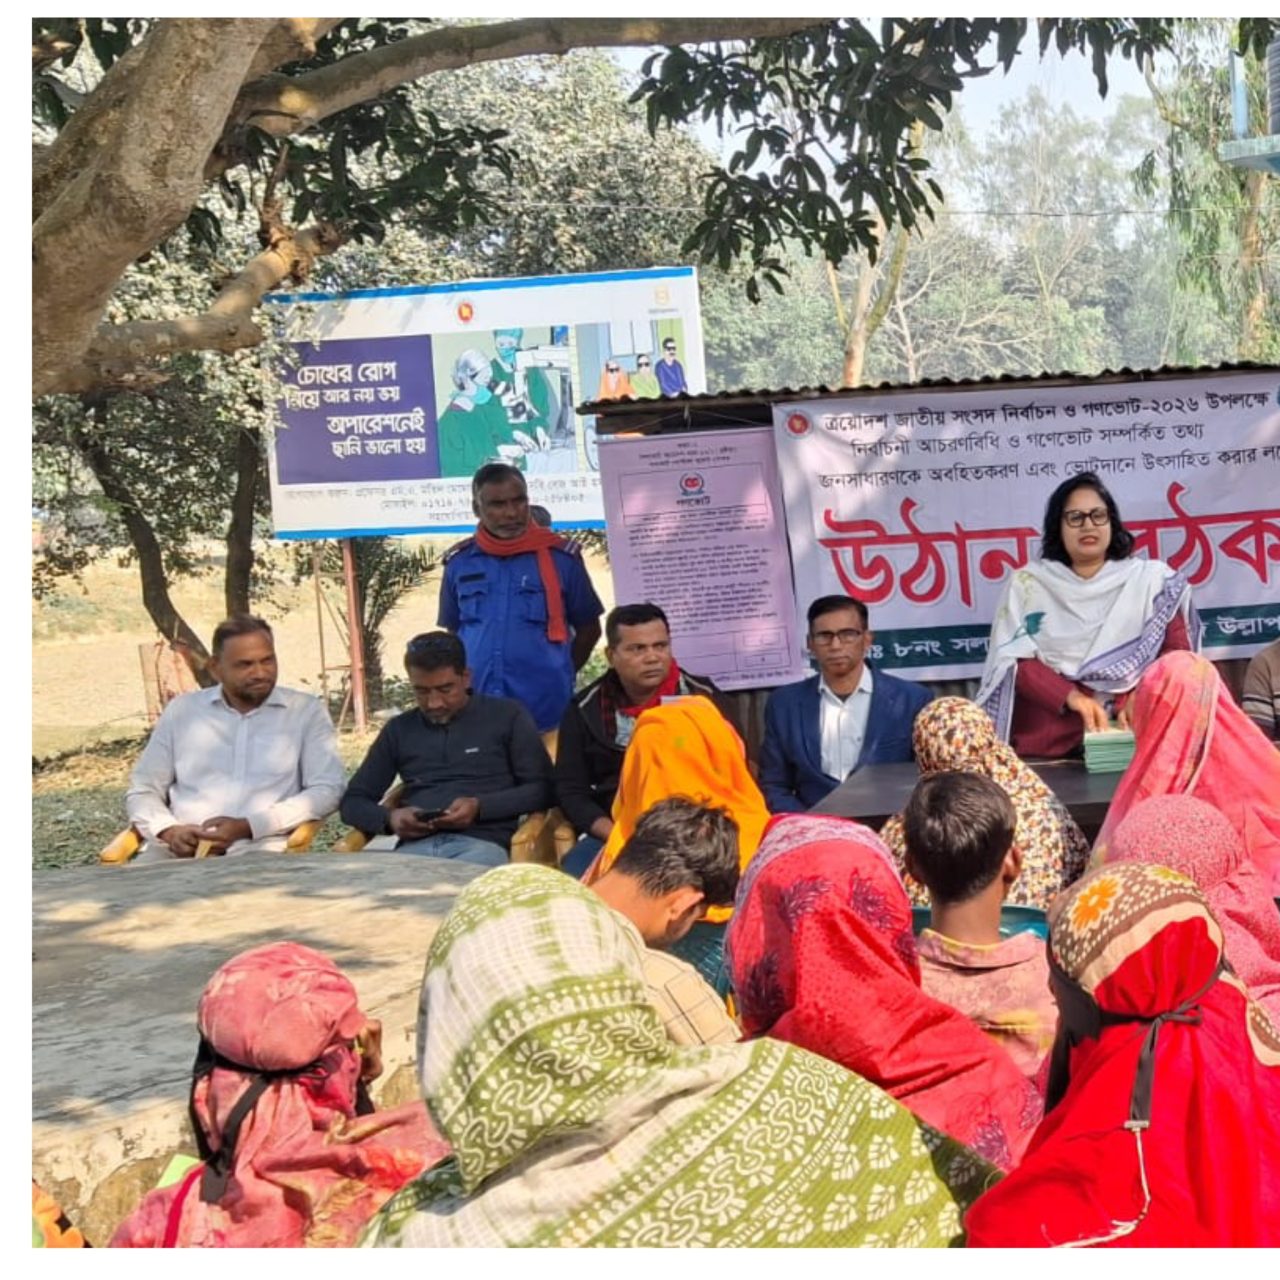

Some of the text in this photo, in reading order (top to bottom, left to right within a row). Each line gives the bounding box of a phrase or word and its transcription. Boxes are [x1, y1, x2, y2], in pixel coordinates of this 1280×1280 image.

[298, 361, 398, 384] চোখের রোগ
[322, 389, 350, 403] আর
[352, 388, 375, 403] নয়
[377, 386, 400, 402] ভয়
[326, 406, 426, 434] অপারেশনেই
[825, 390, 1270, 432] ত্রয়োদশ জাতীয় সংসদ নির্বাচন ও গণভোট-২০২৬ উপলক্ষে
[331, 436, 426, 458] ছানি ভালো হয়
[851, 422, 1205, 457] নির্বাচনী আচরণবিধি ও গণেভোট সম্পর্কিত তথ্য
[818, 470, 921, 489] জনসাধারণকে
[928, 462, 1019, 486] অবহিতকরণ
[1025, 463, 1057, 478] এবং
[1064, 455, 1136, 476] ভোটদানে
[1142, 447, 1212, 472] উৎসাহিত
[1217, 444, 1256, 464] করার
[819, 497, 1044, 609] উঠান
[894, 638, 944, 657] ৮নং
